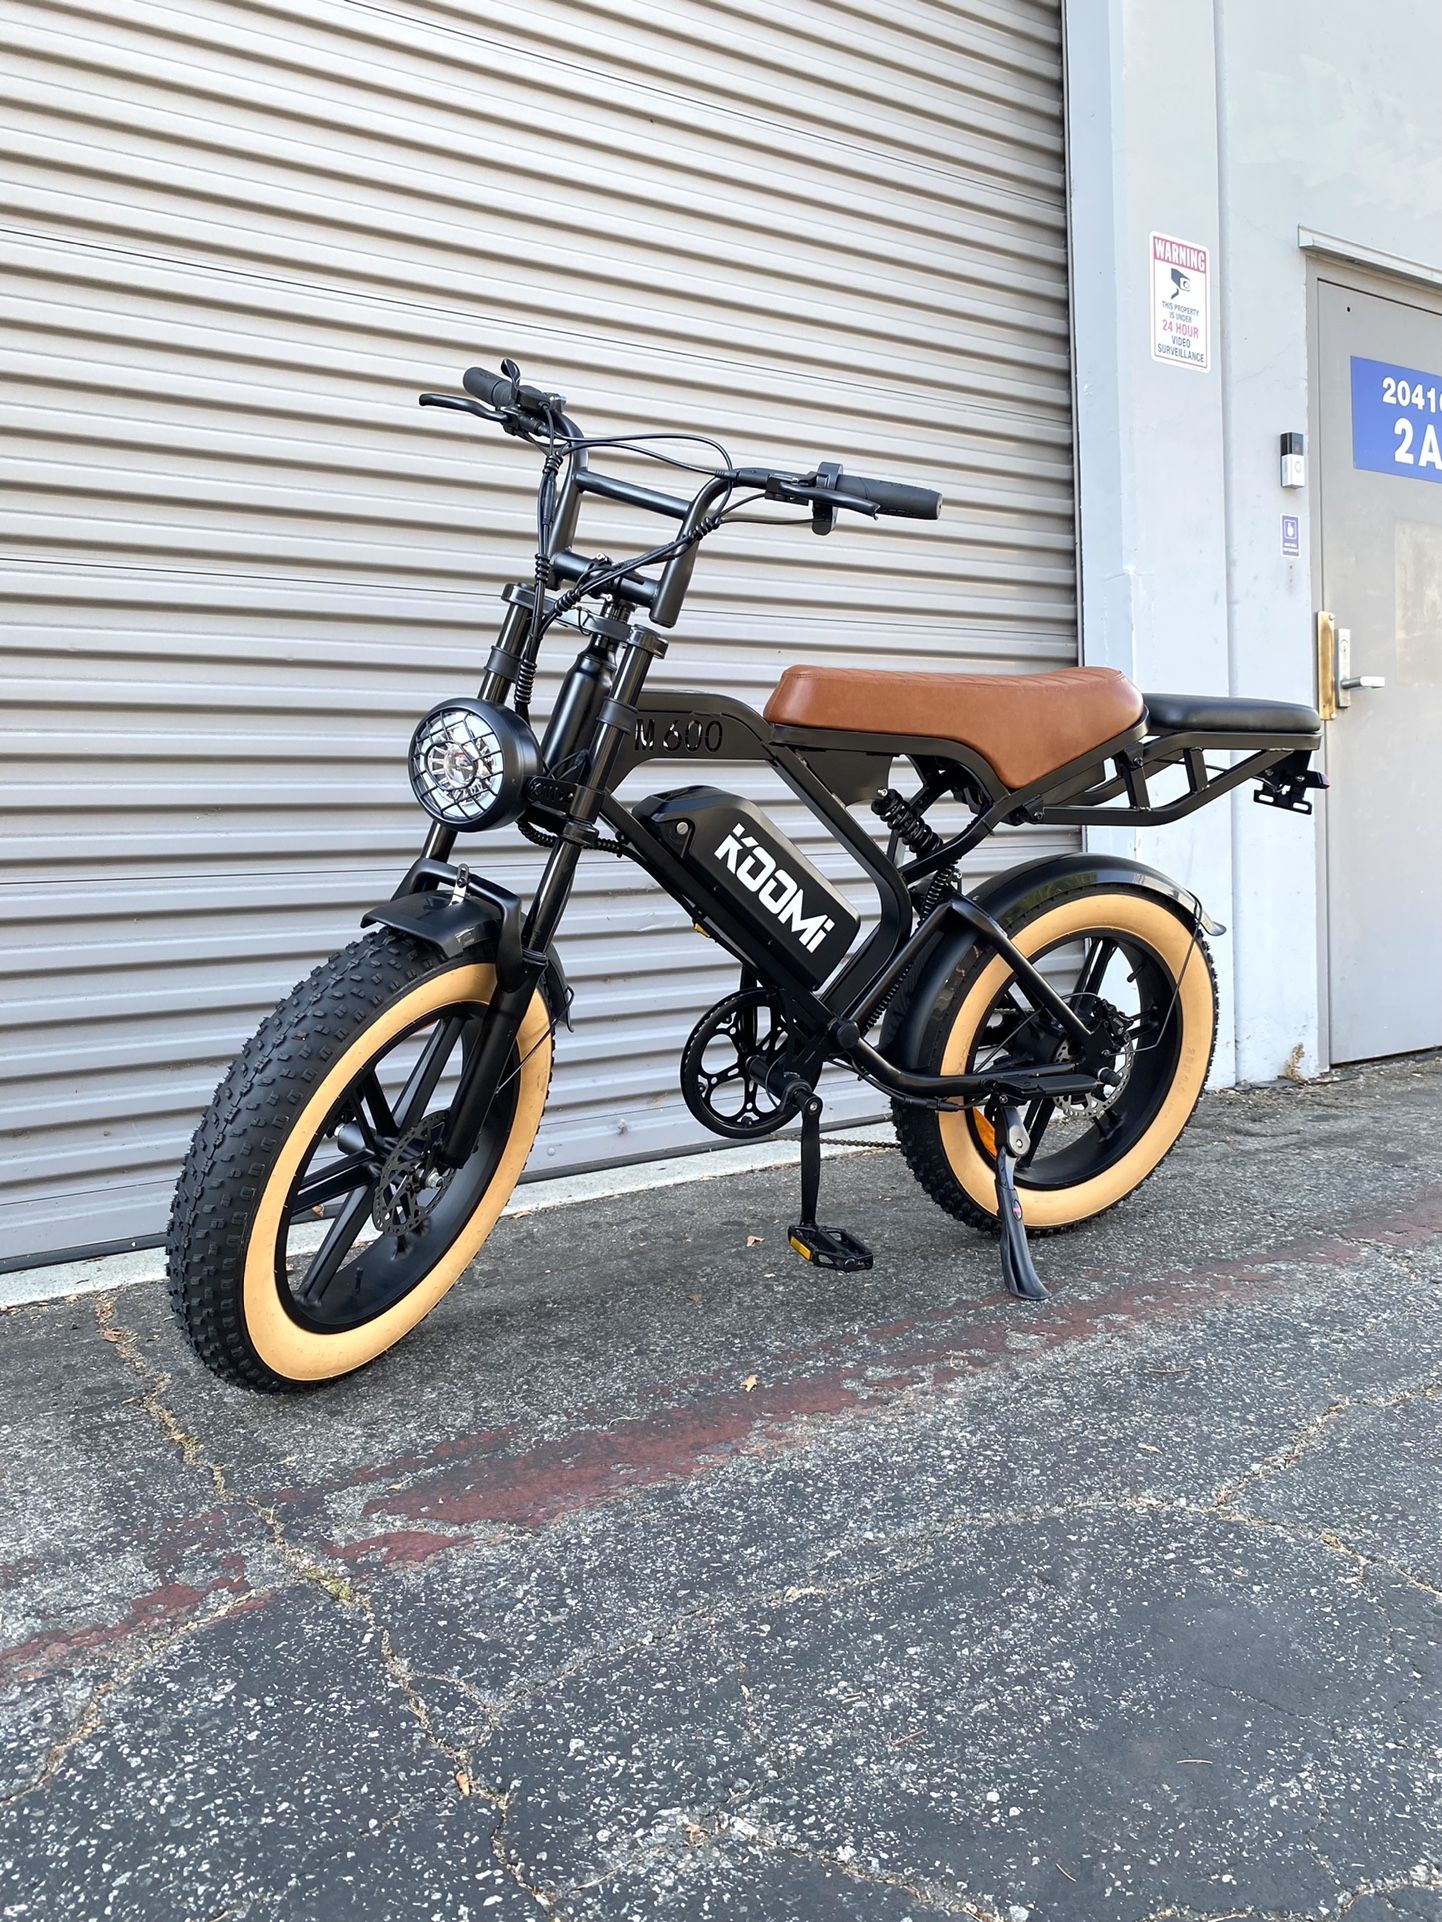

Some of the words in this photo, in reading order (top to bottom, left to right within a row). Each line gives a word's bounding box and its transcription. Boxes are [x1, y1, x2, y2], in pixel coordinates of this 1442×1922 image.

[1155, 239, 1206, 272] WARNING
[1162, 300, 1174, 311] THIS
[1174, 304, 1199, 317] PROPERTY
[1175, 313, 1192, 323] UNDER
[1162, 319, 1173, 332] 24
[1175, 322, 1199, 339] HOUR
[1171, 335, 1191, 349] VIDEO
[1157, 343, 1204, 363] SURVEILLANCE
[1382, 376, 1442, 413] 2041
[1394, 417, 1442, 471] 2A
[662, 719, 723, 752] 600
